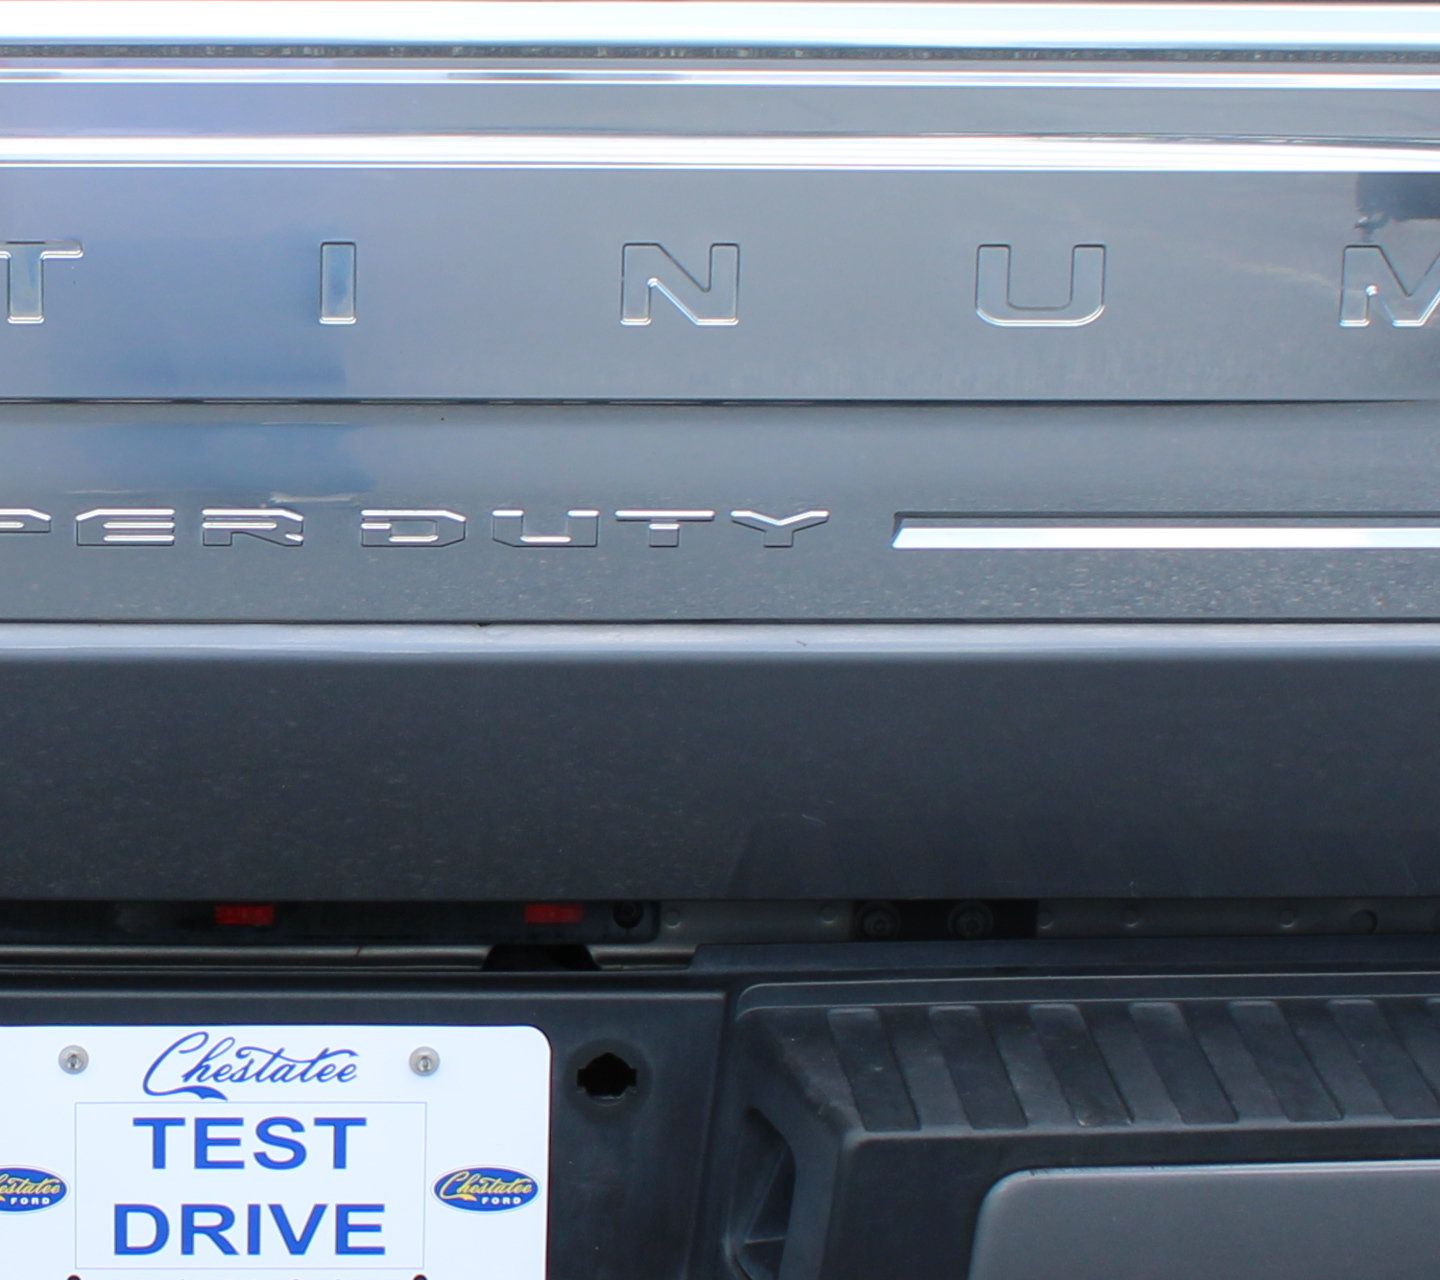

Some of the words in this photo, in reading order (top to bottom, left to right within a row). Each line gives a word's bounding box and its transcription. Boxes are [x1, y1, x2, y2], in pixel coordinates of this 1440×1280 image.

[360, 508, 832, 548] DUTY
[143, 1031, 359, 1101] Chestatee
[133, 1116, 367, 1170] TEST
[10, 1197, 50, 1205] FORD
[439, 1171, 533, 1201] Chestatee
[481, 1196, 521, 1205] FORD
[113, 1204, 386, 1256] DRIVE
